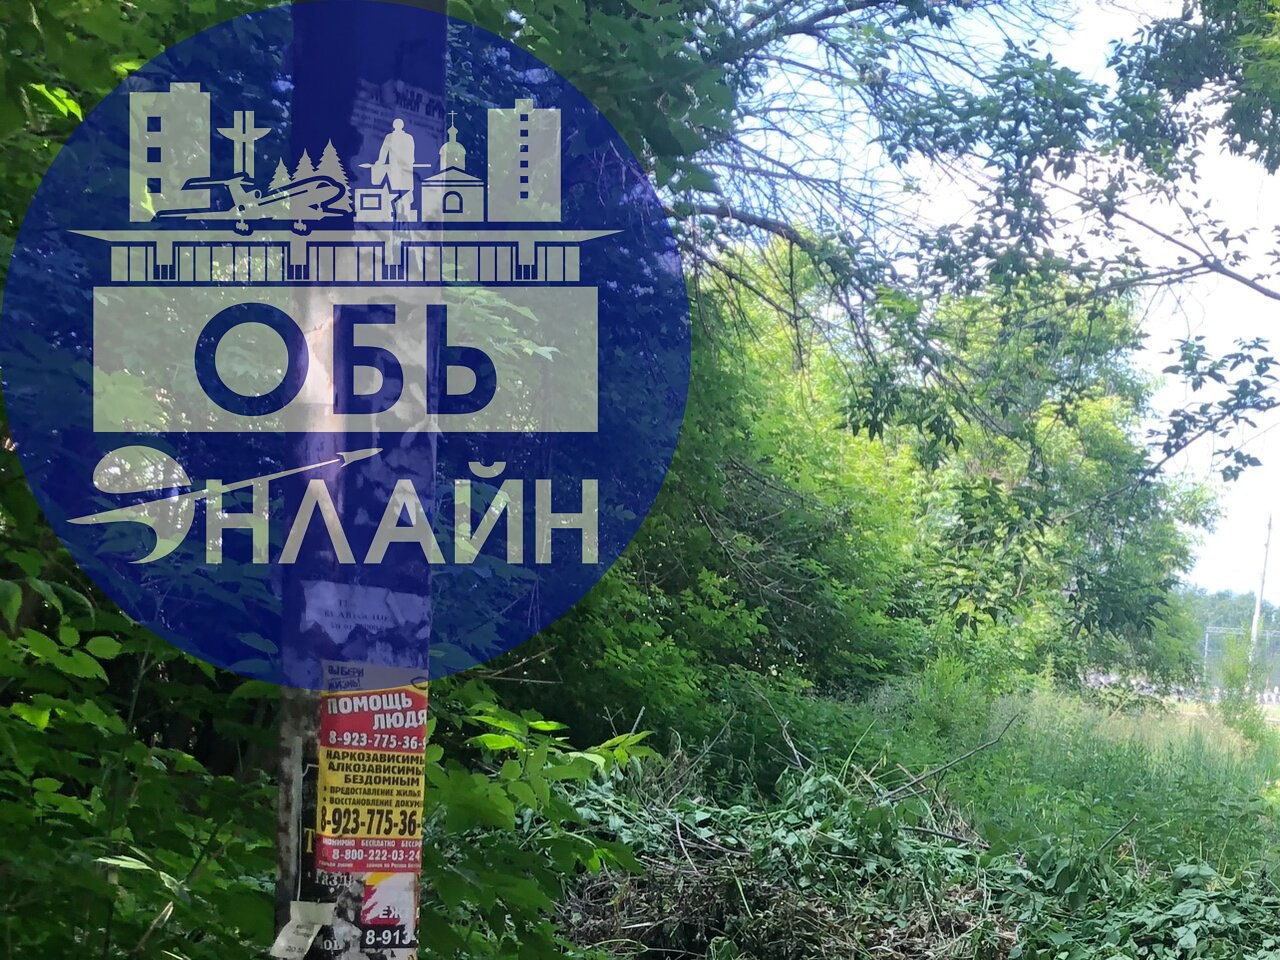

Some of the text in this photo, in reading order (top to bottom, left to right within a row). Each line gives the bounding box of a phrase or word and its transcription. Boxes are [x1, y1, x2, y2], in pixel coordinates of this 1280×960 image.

[327, 692, 413, 715] ПОМОЩЬ
[344, 774, 420, 787] БЕЗДОМНЫМ
[329, 786, 421, 798] ПРЕДОСТАВЛЕНИЕ ЖИЛЬЯ
[329, 796, 393, 807] ВОССТАНОВЛЕНИЕ
